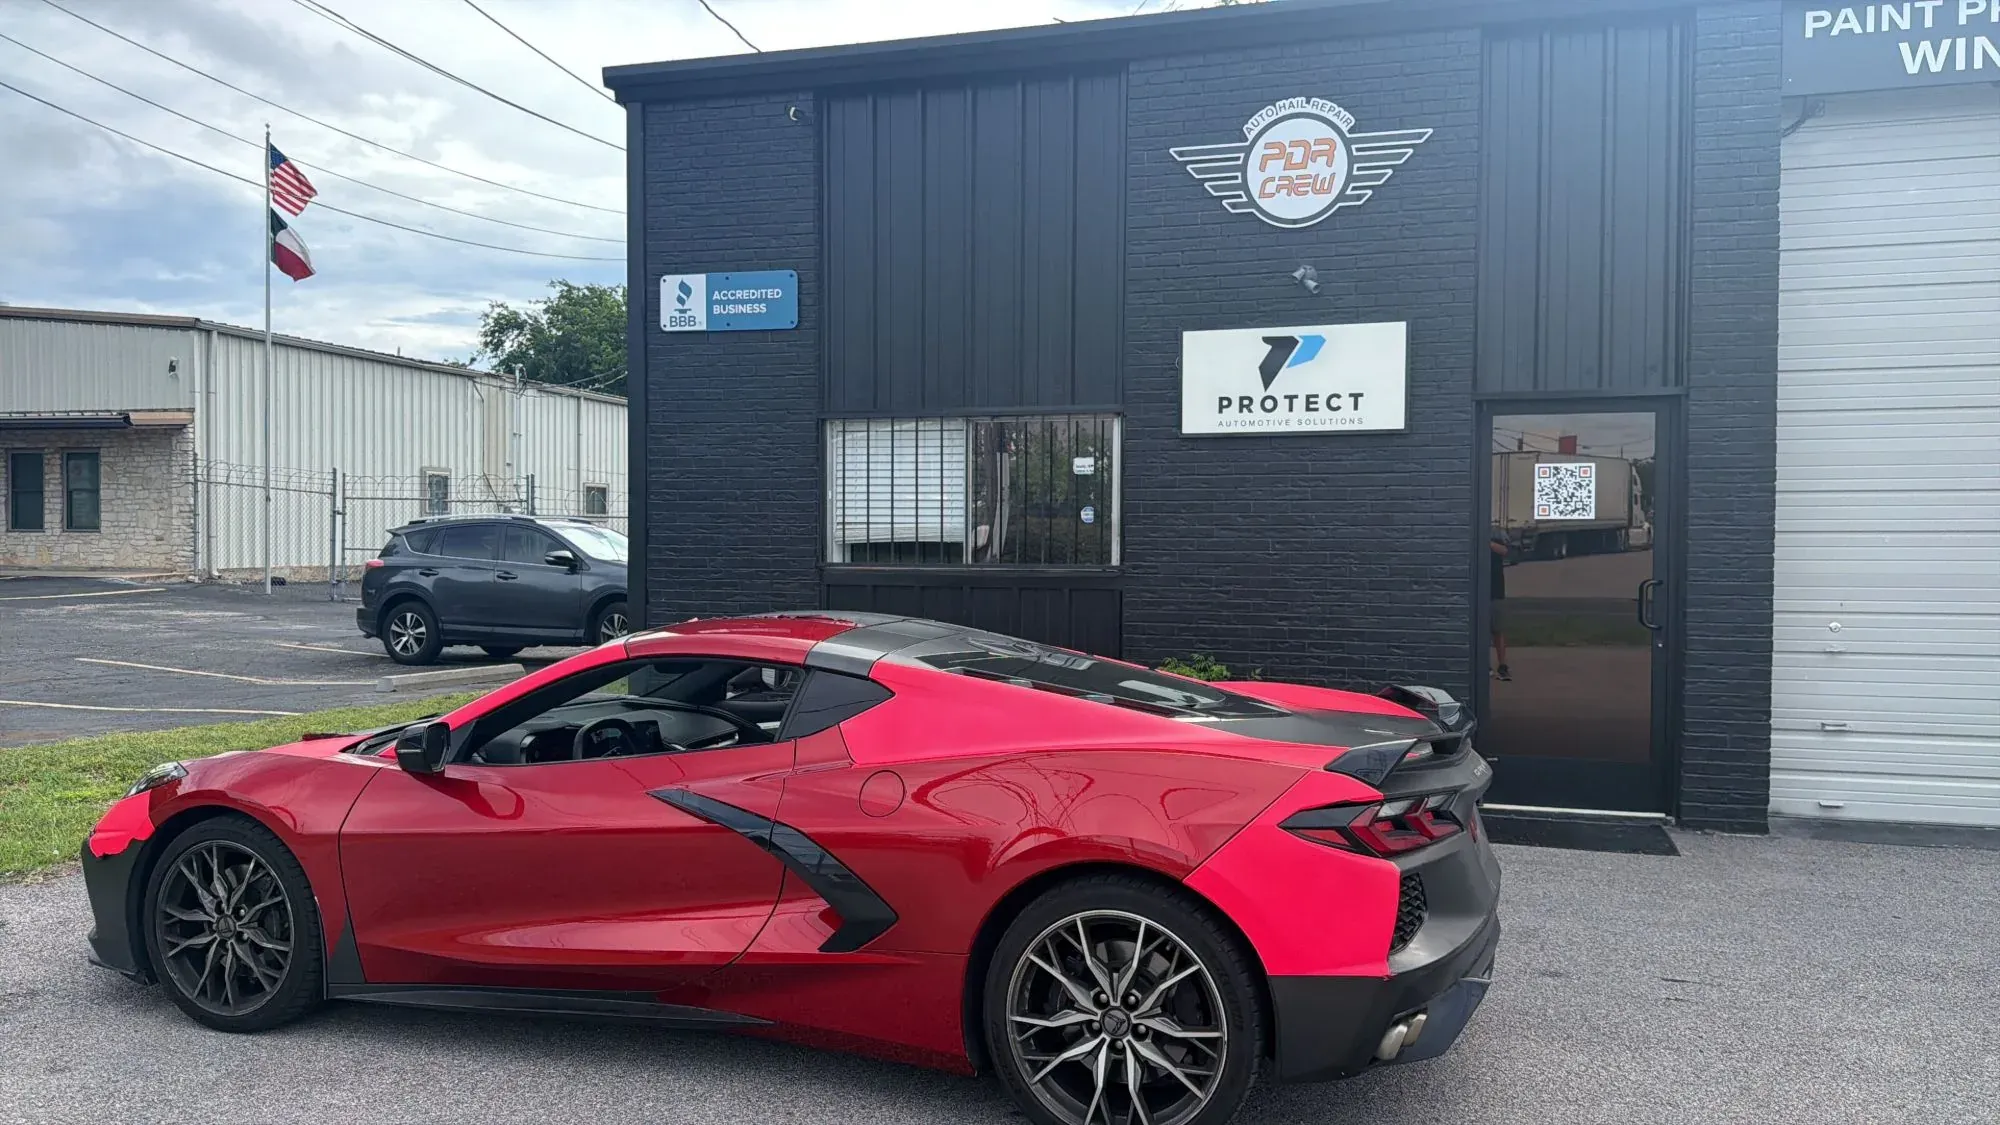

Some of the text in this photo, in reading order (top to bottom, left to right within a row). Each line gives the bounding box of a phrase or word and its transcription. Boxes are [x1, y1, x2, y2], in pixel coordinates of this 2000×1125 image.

[1804, 0, 1943, 38] PAINT
[1898, 36, 2000, 74] WIN
[1245, 99, 1353, 135] AUTO HAIL REPAIR
[1259, 138, 1337, 172] PDR
[1259, 173, 1336, 198] CREW
[712, 288, 782, 300] ACCREDITED
[713, 303, 767, 315] BUSINESS
[669, 315, 697, 328] BBB
[1218, 393, 1364, 414] PROTECT
[1218, 417, 1364, 428] AUTOMOTIVE SOLUTIONS
